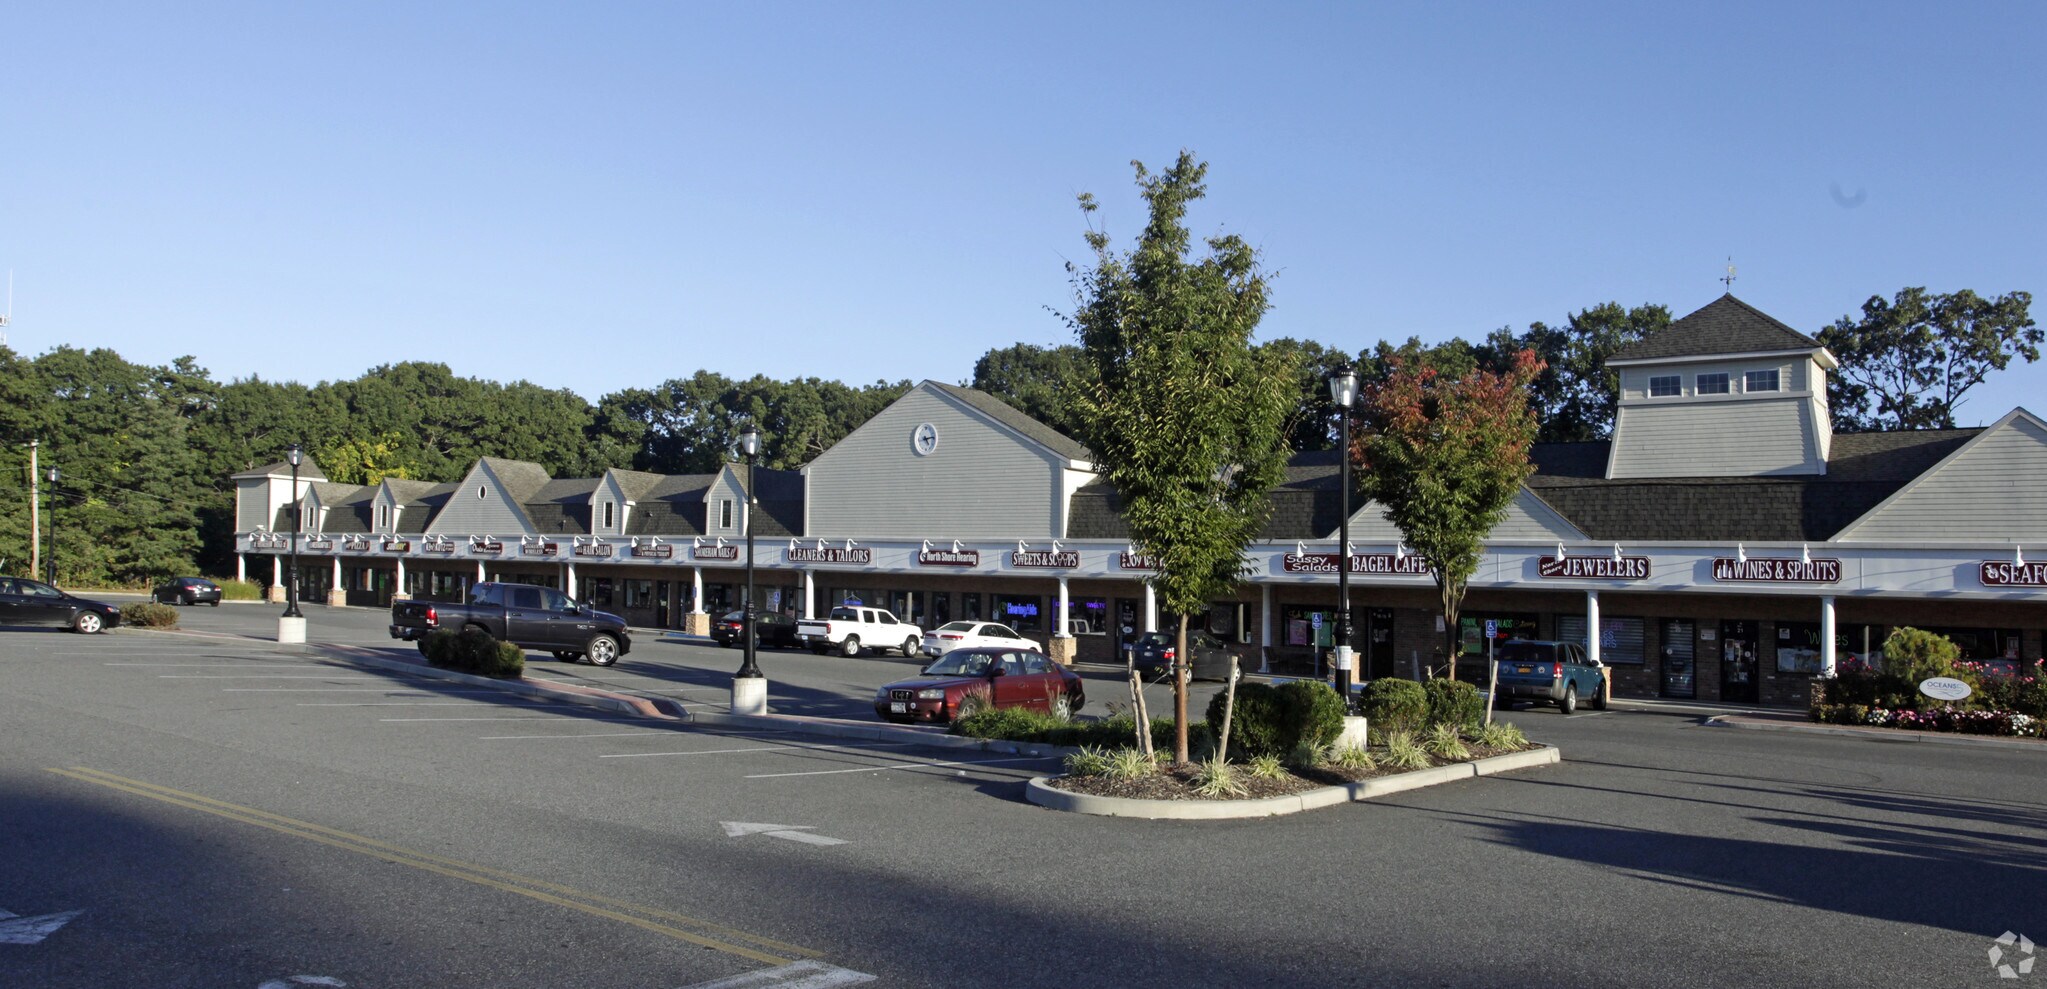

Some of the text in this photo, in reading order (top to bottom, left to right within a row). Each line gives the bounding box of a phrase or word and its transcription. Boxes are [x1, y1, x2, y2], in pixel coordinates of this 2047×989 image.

[583, 545, 595, 555] HAIR
[595, 545, 611, 556] SALON
[694, 547, 730, 558] SHOREHAM NAILS
[788, 549, 869, 563] CLEANERS & TAILORS
[926, 551, 977, 564] North Shore Hearing
[1013, 552, 1042, 566] SWEETS
[1042, 553, 1048, 566] &
[1286, 555, 1328, 566] Sassy
[1291, 562, 1339, 572] Salads
[1352, 556, 1426, 573] BAGEL CAFE
[1543, 565, 1563, 576] Shore
[1563, 558, 1646, 577] JEWELERS
[1733, 560, 1837, 580] WINES & SPIRITS
[1804, 629, 1849, 646] Wes
[1927, 681, 1957, 689] OCEANS
